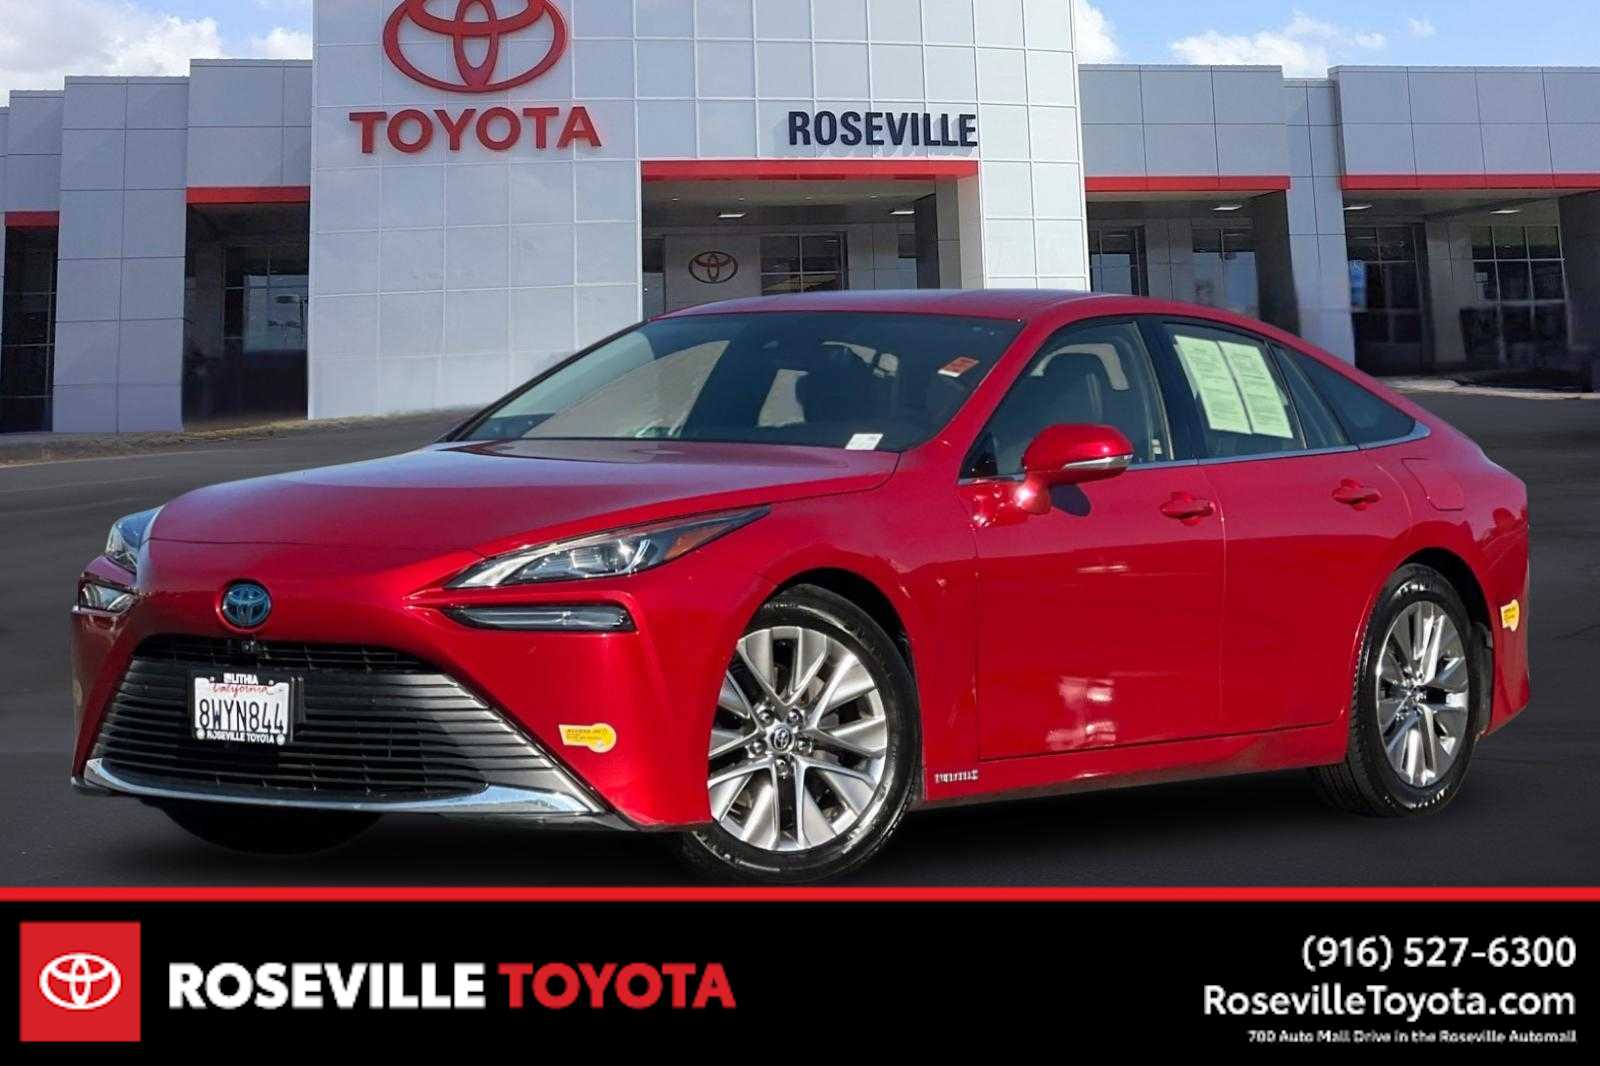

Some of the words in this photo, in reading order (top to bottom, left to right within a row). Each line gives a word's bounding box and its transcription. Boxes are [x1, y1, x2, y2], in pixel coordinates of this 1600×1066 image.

[349, 106, 602, 154] TOYOTA
[788, 111, 978, 147] ROSEVILLE
[199, 699, 284, 734] 8WYN844
[207, 730, 245, 742] ROSEVILLE
[246, 732, 275, 744] TOYOTA
